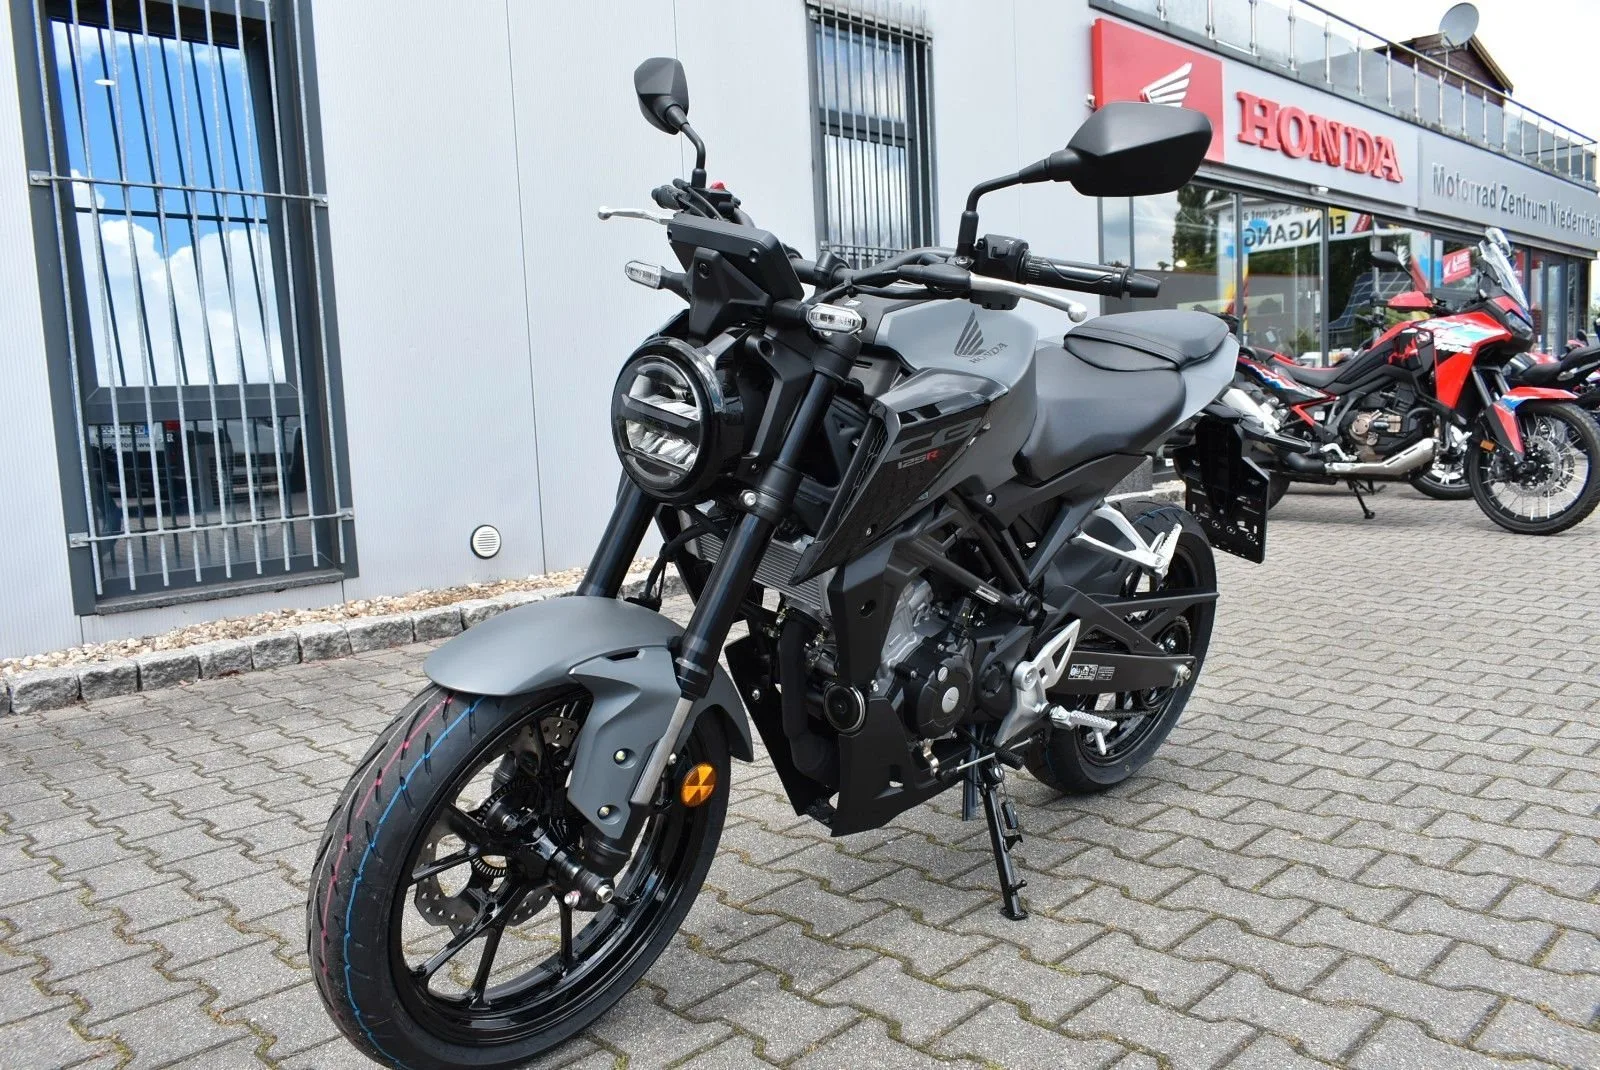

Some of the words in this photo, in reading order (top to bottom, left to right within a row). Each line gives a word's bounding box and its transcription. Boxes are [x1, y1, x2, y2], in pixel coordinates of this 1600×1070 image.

[1236, 91, 1403, 183] HONDA
[1432, 162, 1496, 209] Motorrad
[1501, 185, 1547, 224] Zentrum
[969, 342, 1008, 363] HONDA
[898, 449, 941, 470] 125R
